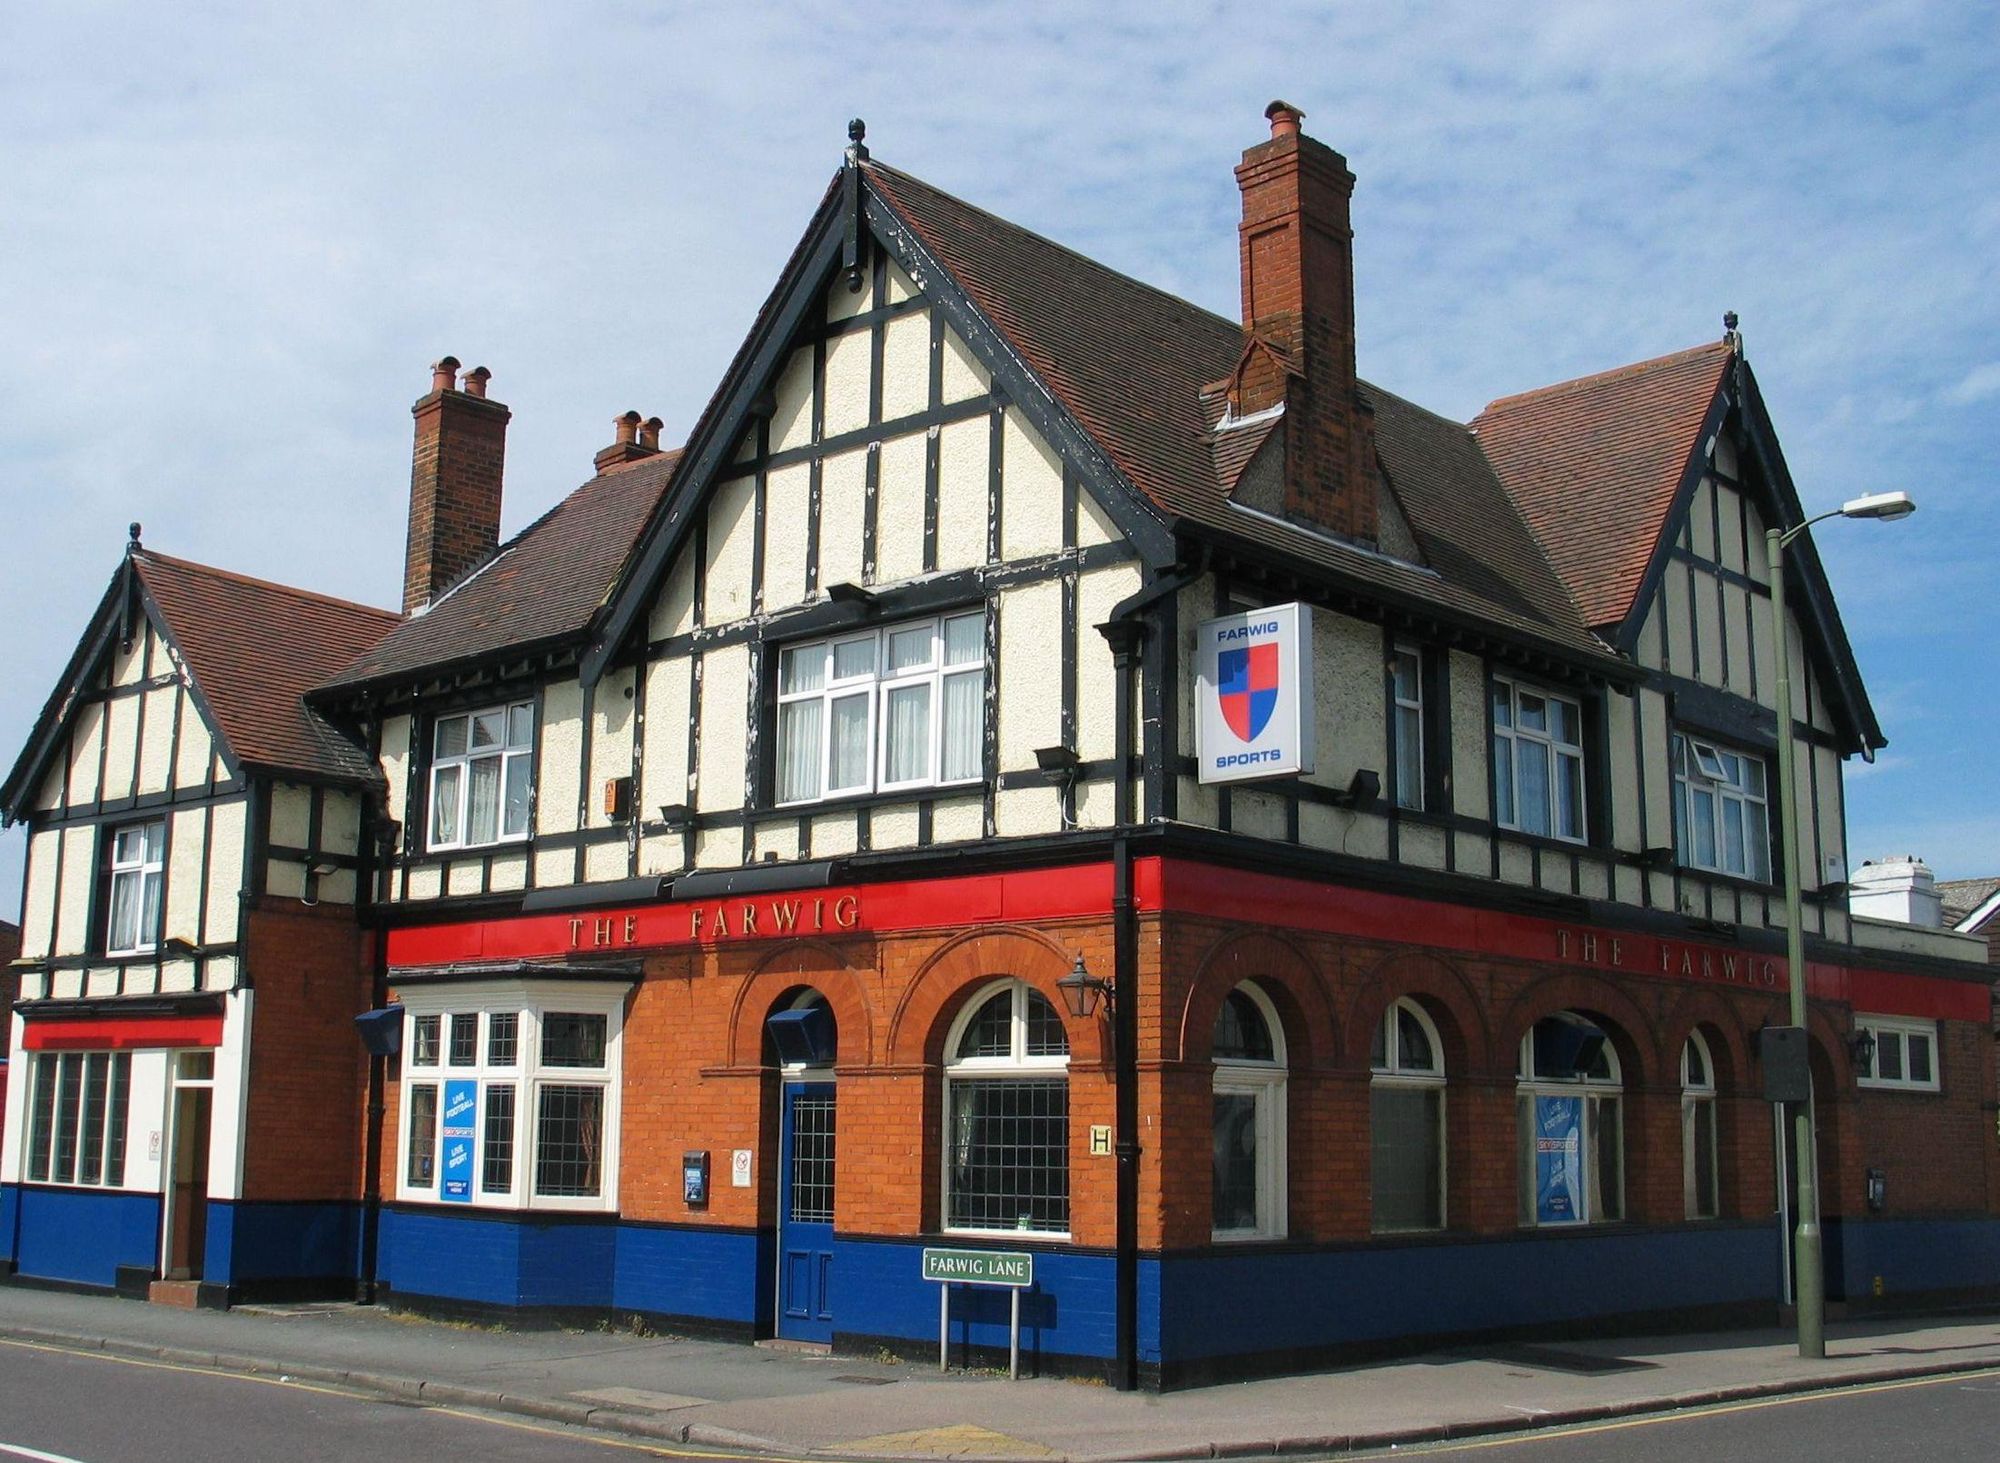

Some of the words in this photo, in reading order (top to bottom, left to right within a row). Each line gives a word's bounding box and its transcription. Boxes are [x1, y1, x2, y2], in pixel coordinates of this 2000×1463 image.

[1217, 622, 1279, 642] FARWIG
[1216, 749, 1281, 768] SPORTS
[568, 917, 639, 947] THE
[689, 895, 858, 939] FARWIG
[1557, 928, 1623, 966] THE
[1661, 944, 1776, 986] FARWIG
[446, 1098, 474, 1119] FOOTBALL
[1093, 1129, 1109, 1152] H
[930, 1257, 983, 1275] FARWIG
[988, 1260, 1025, 1277] LANE
